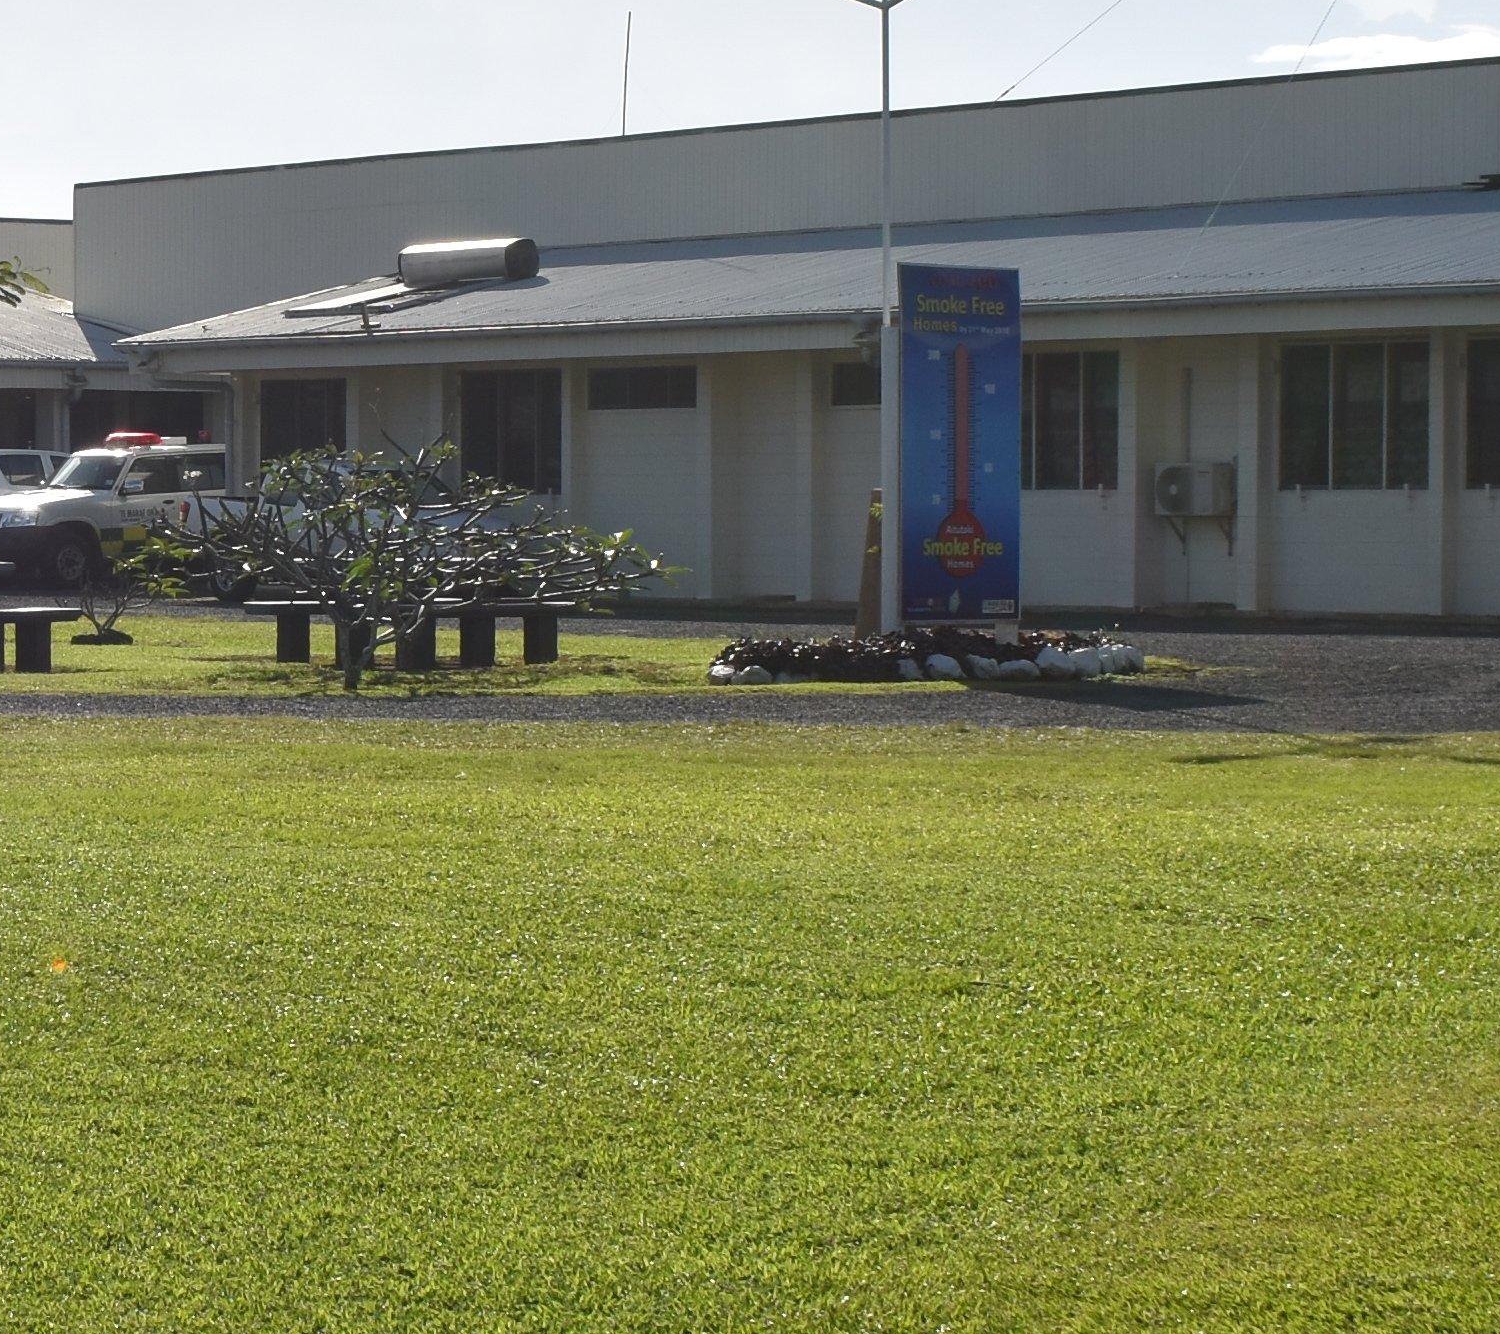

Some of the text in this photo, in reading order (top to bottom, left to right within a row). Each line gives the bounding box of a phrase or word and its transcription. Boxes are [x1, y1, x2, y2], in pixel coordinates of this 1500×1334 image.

[916, 294, 1005, 316] Smoke Free
[913, 317, 957, 332] Homes
[922, 537, 1003, 556] Smoke Free
[947, 559, 974, 569] Homes
